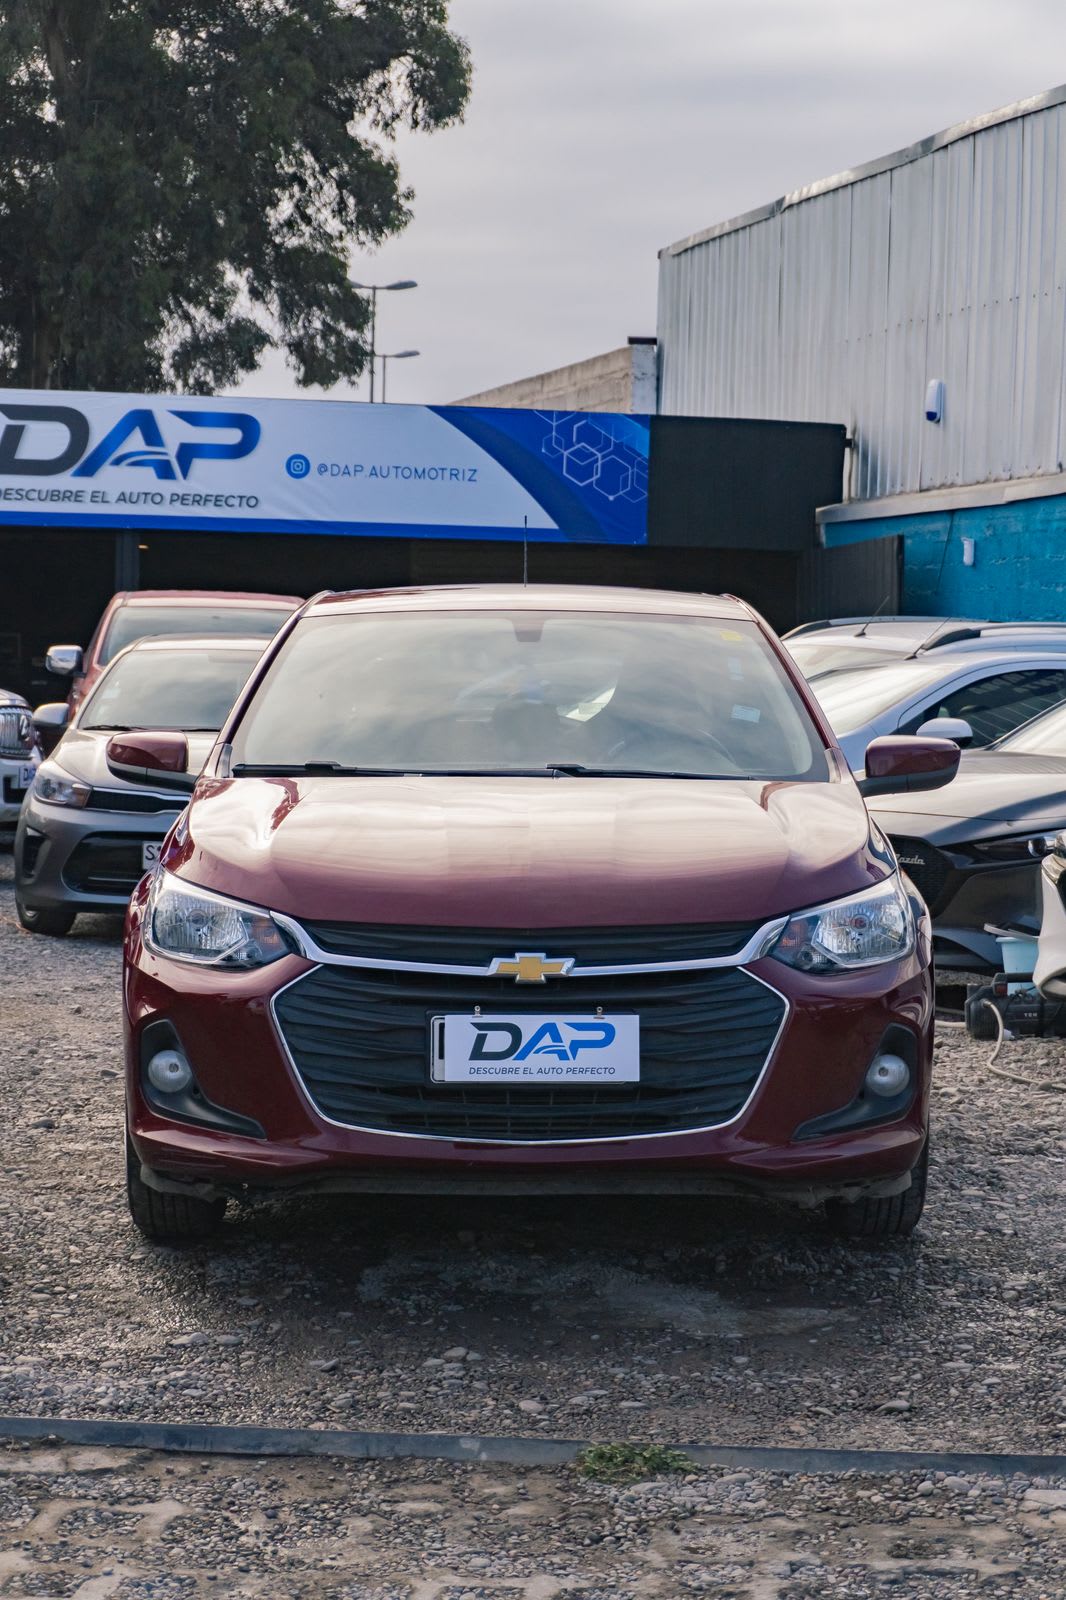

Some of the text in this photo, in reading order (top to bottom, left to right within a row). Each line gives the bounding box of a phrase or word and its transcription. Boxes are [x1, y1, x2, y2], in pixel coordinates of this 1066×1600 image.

[0, 404, 261, 480] DAP
[317, 463, 478, 482] @DAP.AUTOMOTRIZ
[0, 488, 259, 508] ESCUBRE EL AUTO PERFECTO
[468, 1022, 616, 1061] DAP
[469, 1067, 616, 1075] DESCUBRE EL AUTO PERFECTO
